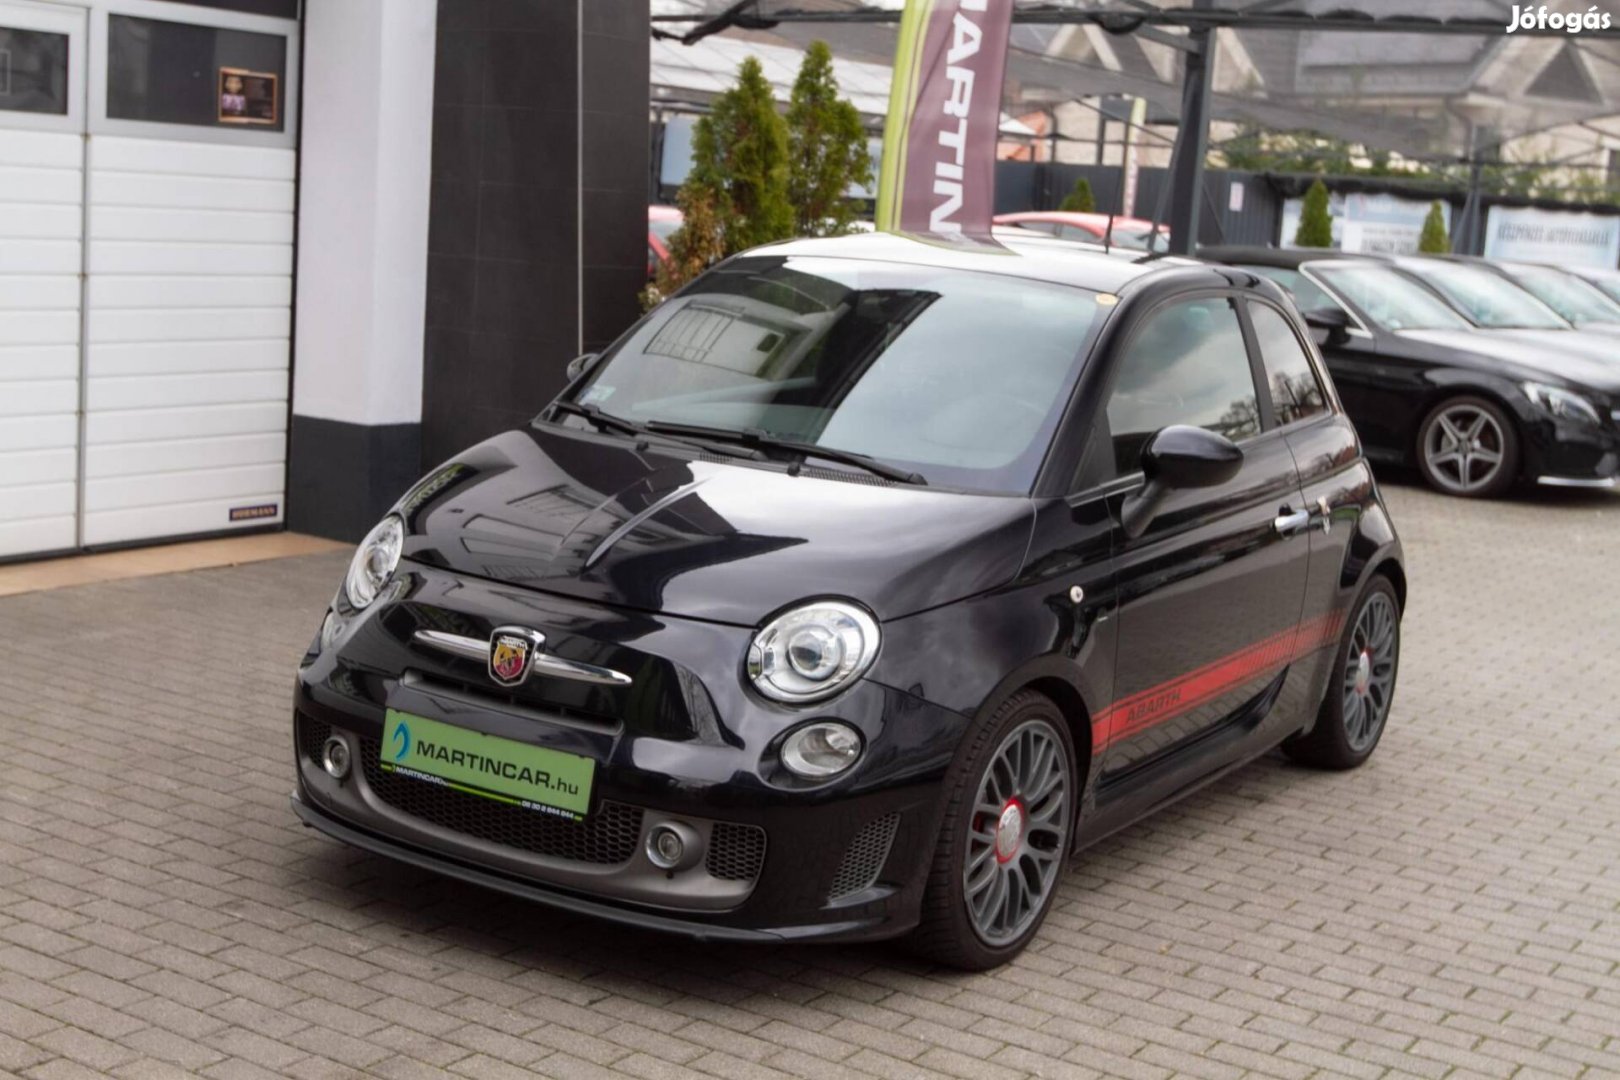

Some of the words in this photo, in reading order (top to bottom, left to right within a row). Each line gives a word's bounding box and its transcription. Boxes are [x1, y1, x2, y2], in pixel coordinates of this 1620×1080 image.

[929, 0, 989, 233] ARTIN
[1126, 688, 1182, 723] ABARTH
[416, 739, 579, 796] MARTINCAR.hu
